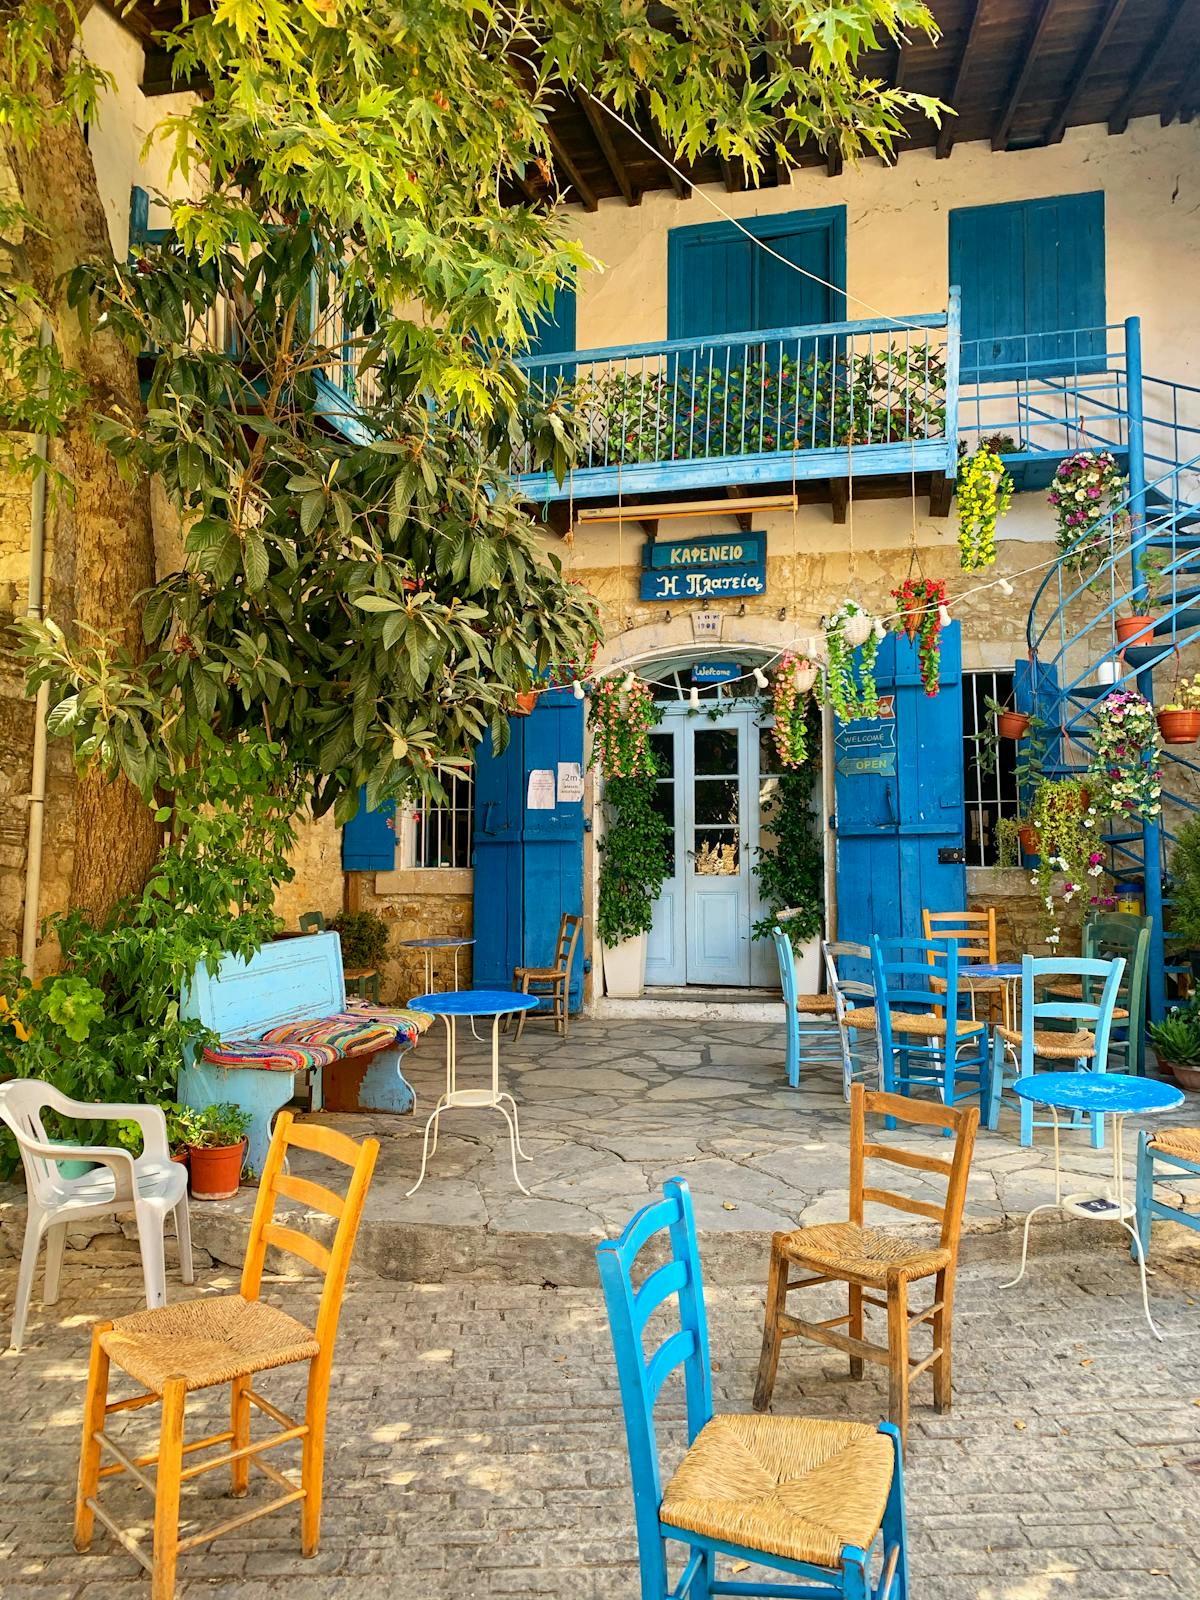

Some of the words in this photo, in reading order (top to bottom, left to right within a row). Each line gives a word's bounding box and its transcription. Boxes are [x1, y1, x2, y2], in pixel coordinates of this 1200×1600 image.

[670, 545, 743, 564] ΚΑΦΕΝΕΙΟ
[656, 576, 681, 597] Η
[694, 665, 731, 676] Welcome
[844, 733, 885, 743] WELCOME
[856, 760, 887, 770] OPEN
